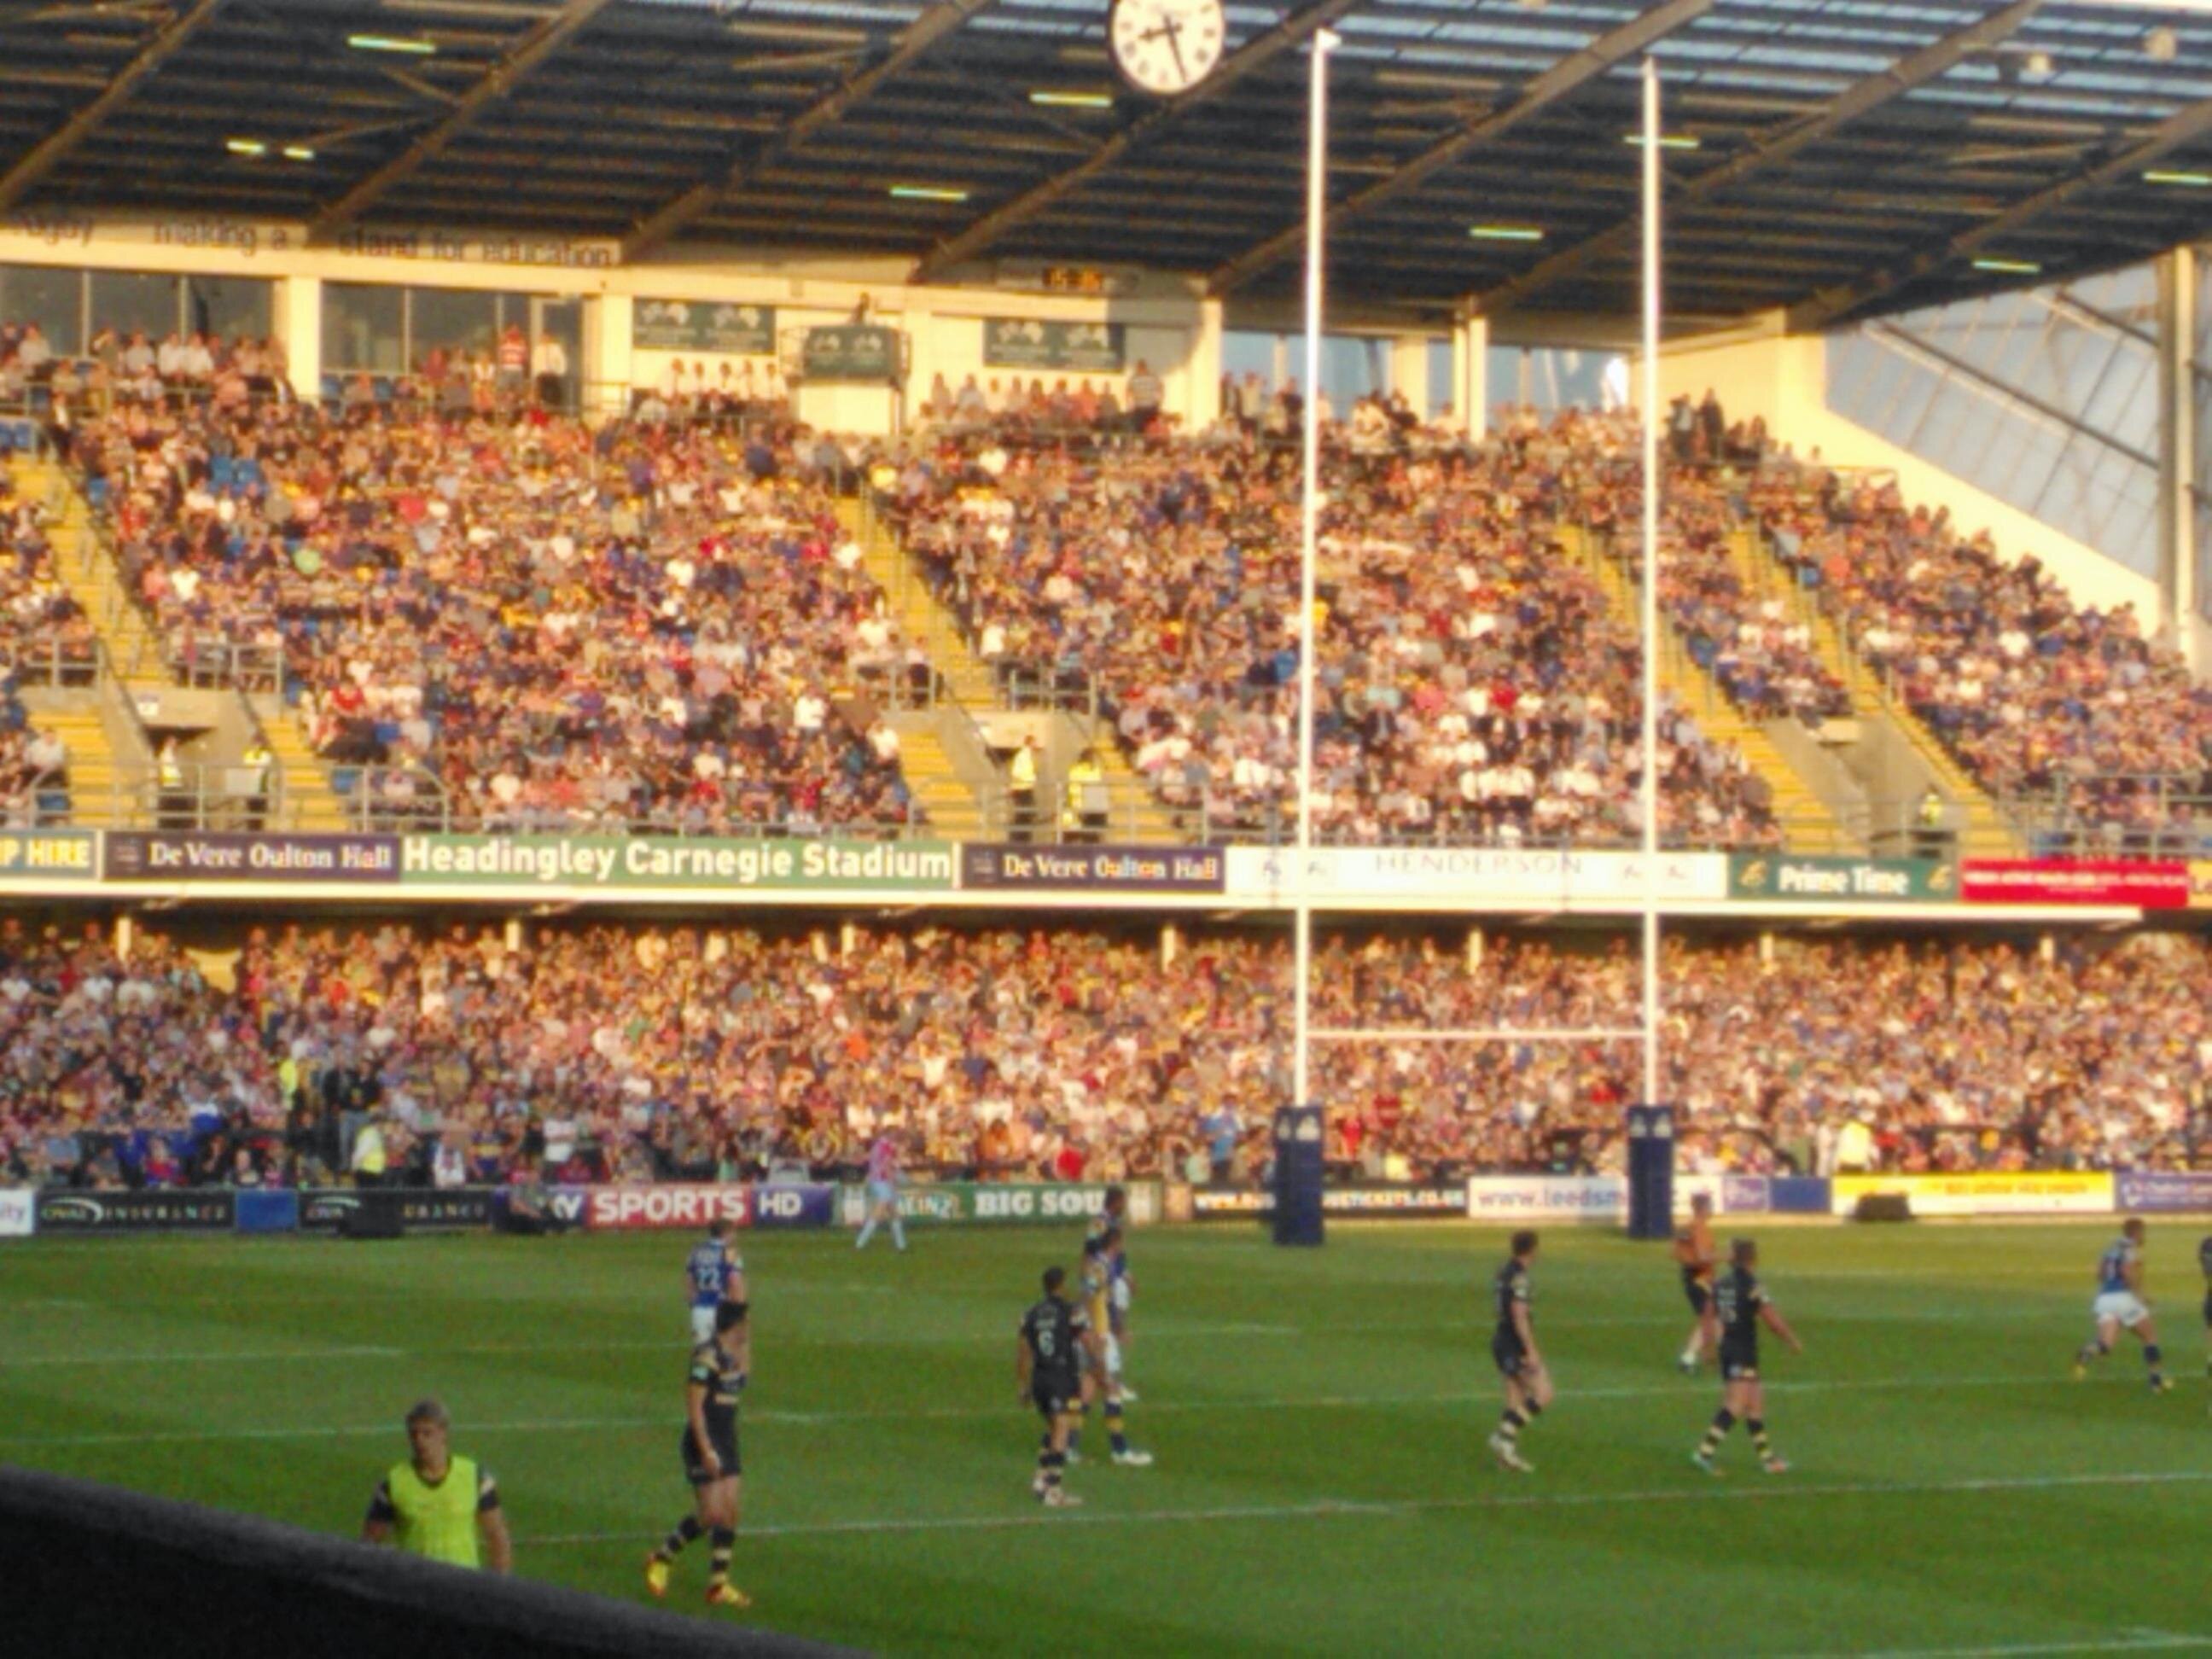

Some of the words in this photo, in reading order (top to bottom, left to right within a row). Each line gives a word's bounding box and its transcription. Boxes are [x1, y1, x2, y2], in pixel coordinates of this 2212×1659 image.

[26, 840, 90, 869] HIRE
[148, 841, 183, 866] De
[186, 841, 242, 868] Vere
[249, 843, 334, 869] Oulton
[342, 845, 393, 870] Hall
[404, 837, 616, 882] Headingley
[626, 843, 792, 883] Carnegie
[802, 841, 952, 881] Stadium
[1004, 853, 1032, 879] De
[1035, 854, 1088, 879] Vere
[1096, 854, 1167, 880] Oulton
[1173, 856, 1219, 881] Hall
[1375, 852, 1582, 875] HENDERSON
[1778, 864, 1848, 893] Prime
[1854, 866, 1910, 894] Time
[596, 1190, 745, 1222] SPORTS
[760, 1192, 801, 1216] HD
[975, 1190, 1033, 1216] BIG
[1041, 1191, 1107, 1215] SOU
